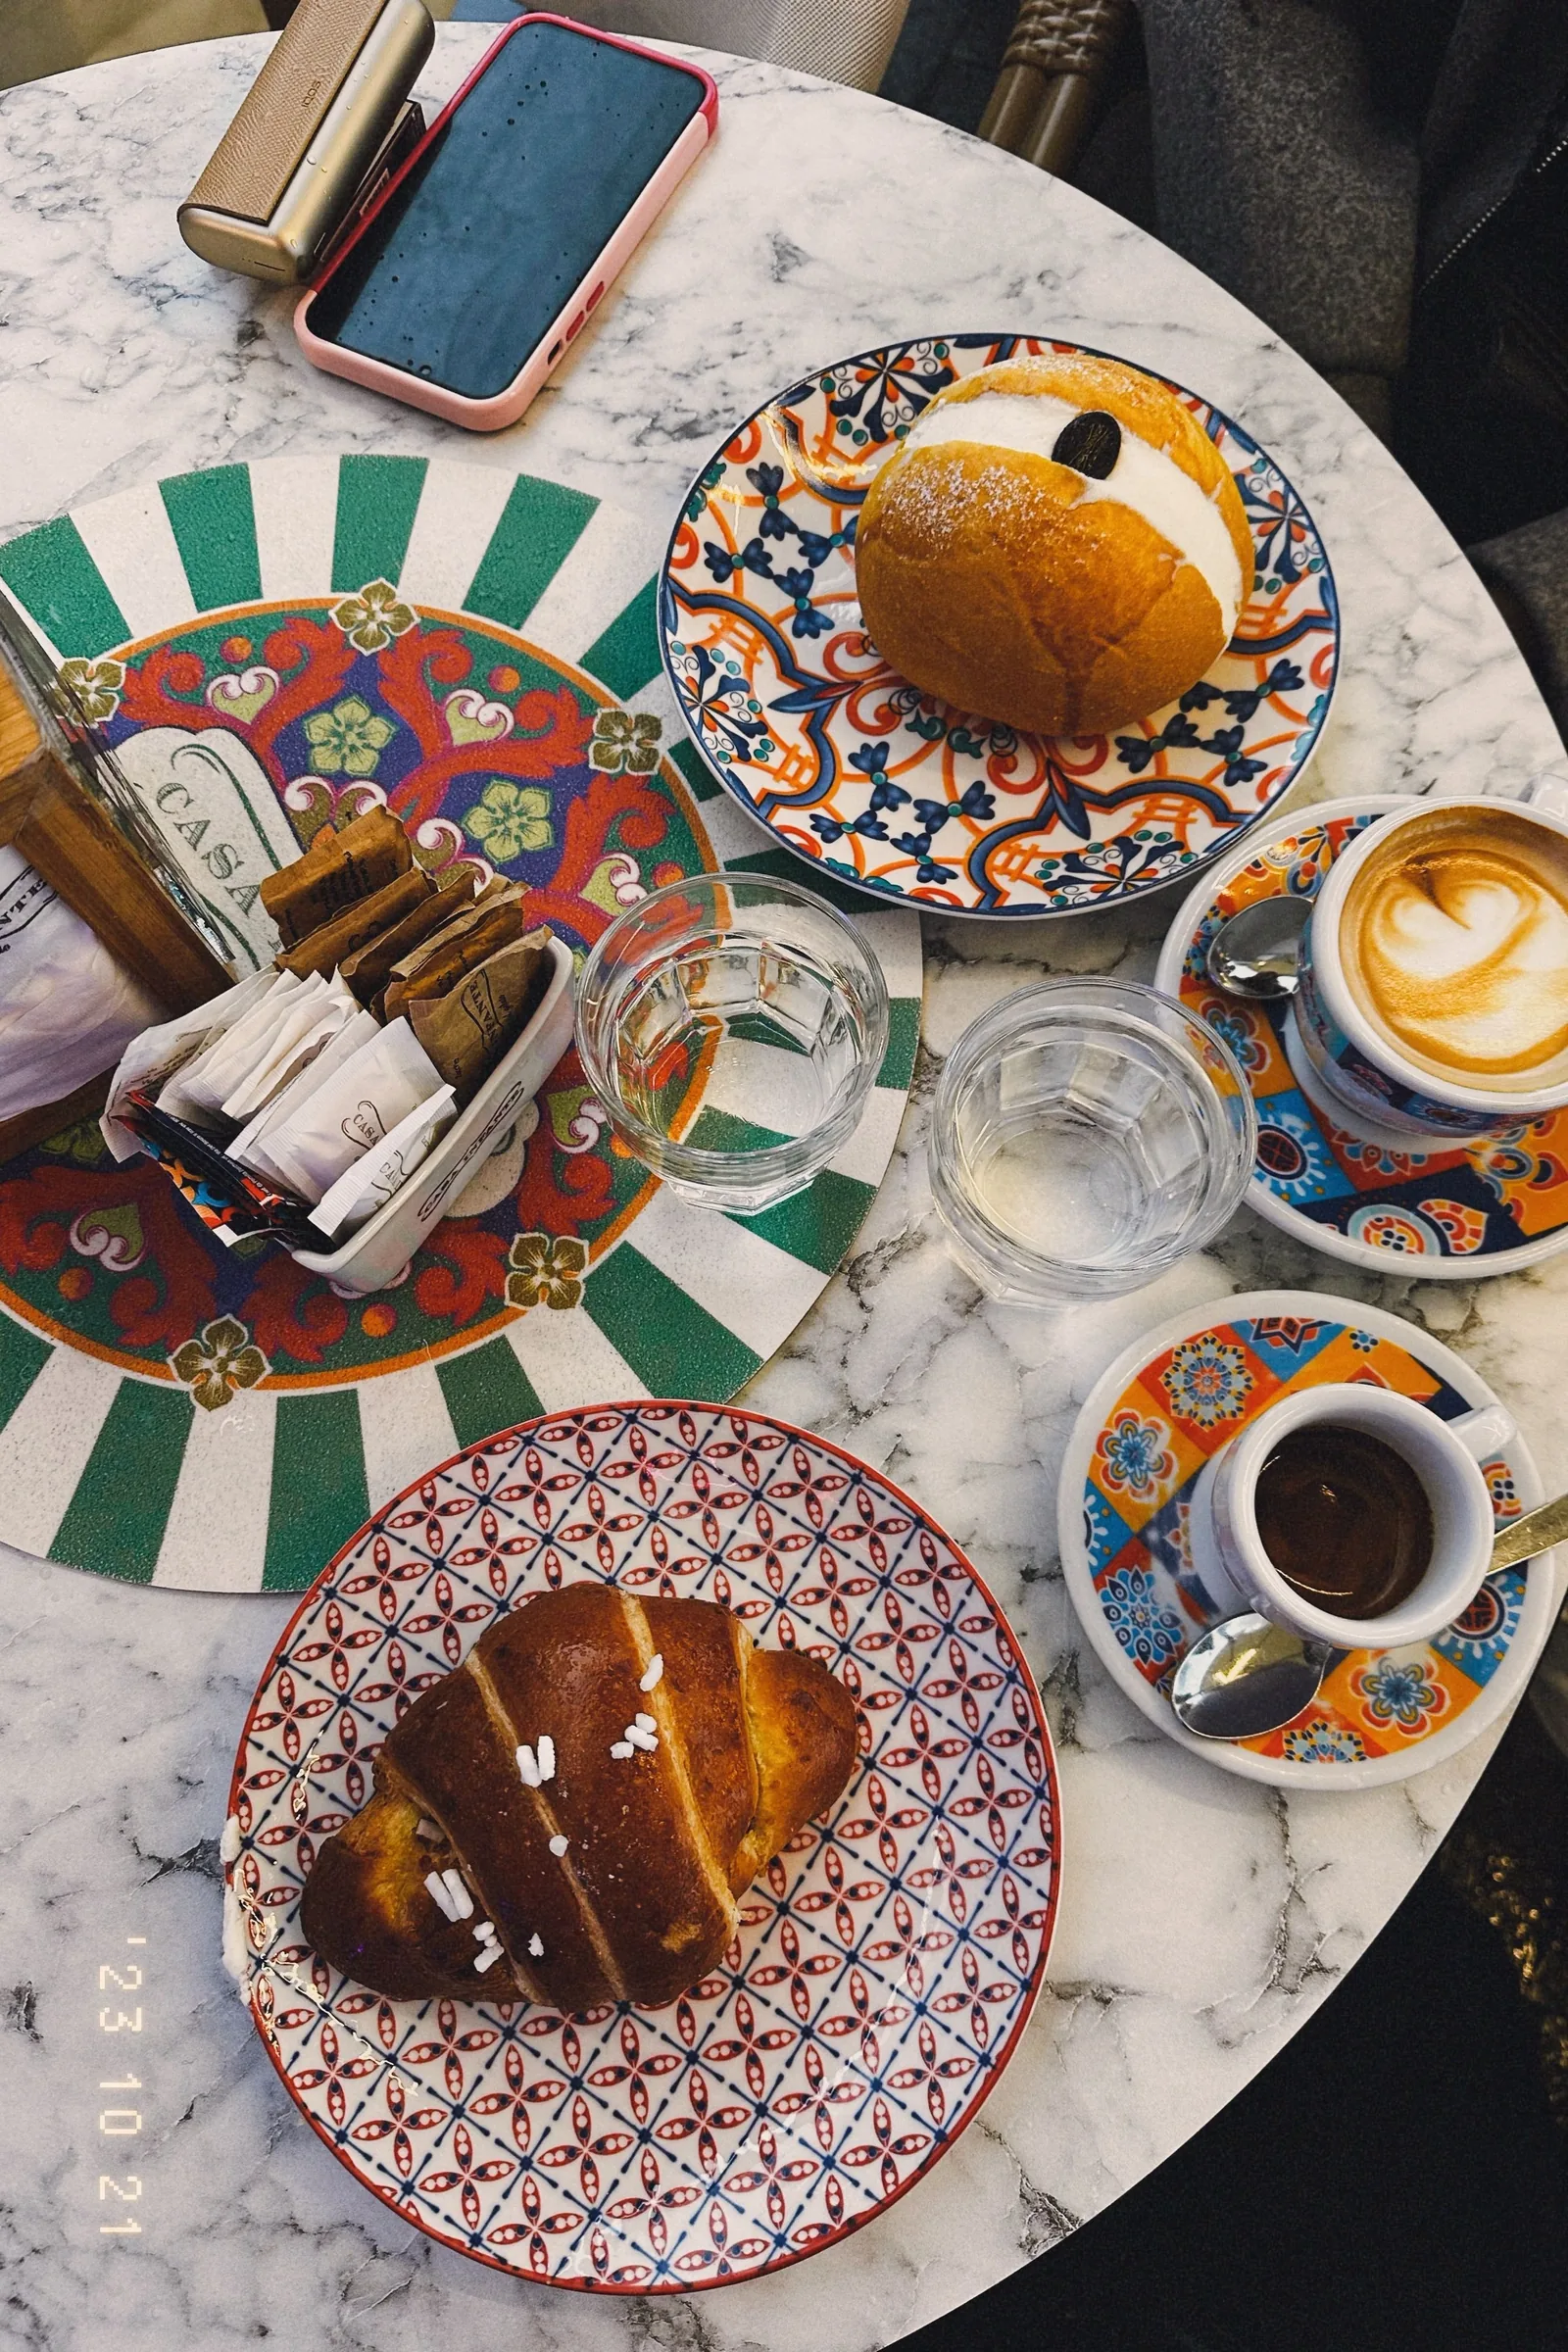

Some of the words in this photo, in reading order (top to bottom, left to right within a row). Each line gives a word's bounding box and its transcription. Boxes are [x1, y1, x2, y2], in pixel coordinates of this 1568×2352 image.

[156, 782, 262, 918] CASA
[353, 1113, 381, 1146] CASA
[424, 1169, 460, 1213] CASA
[464, 1089, 520, 1163] INFANTE
